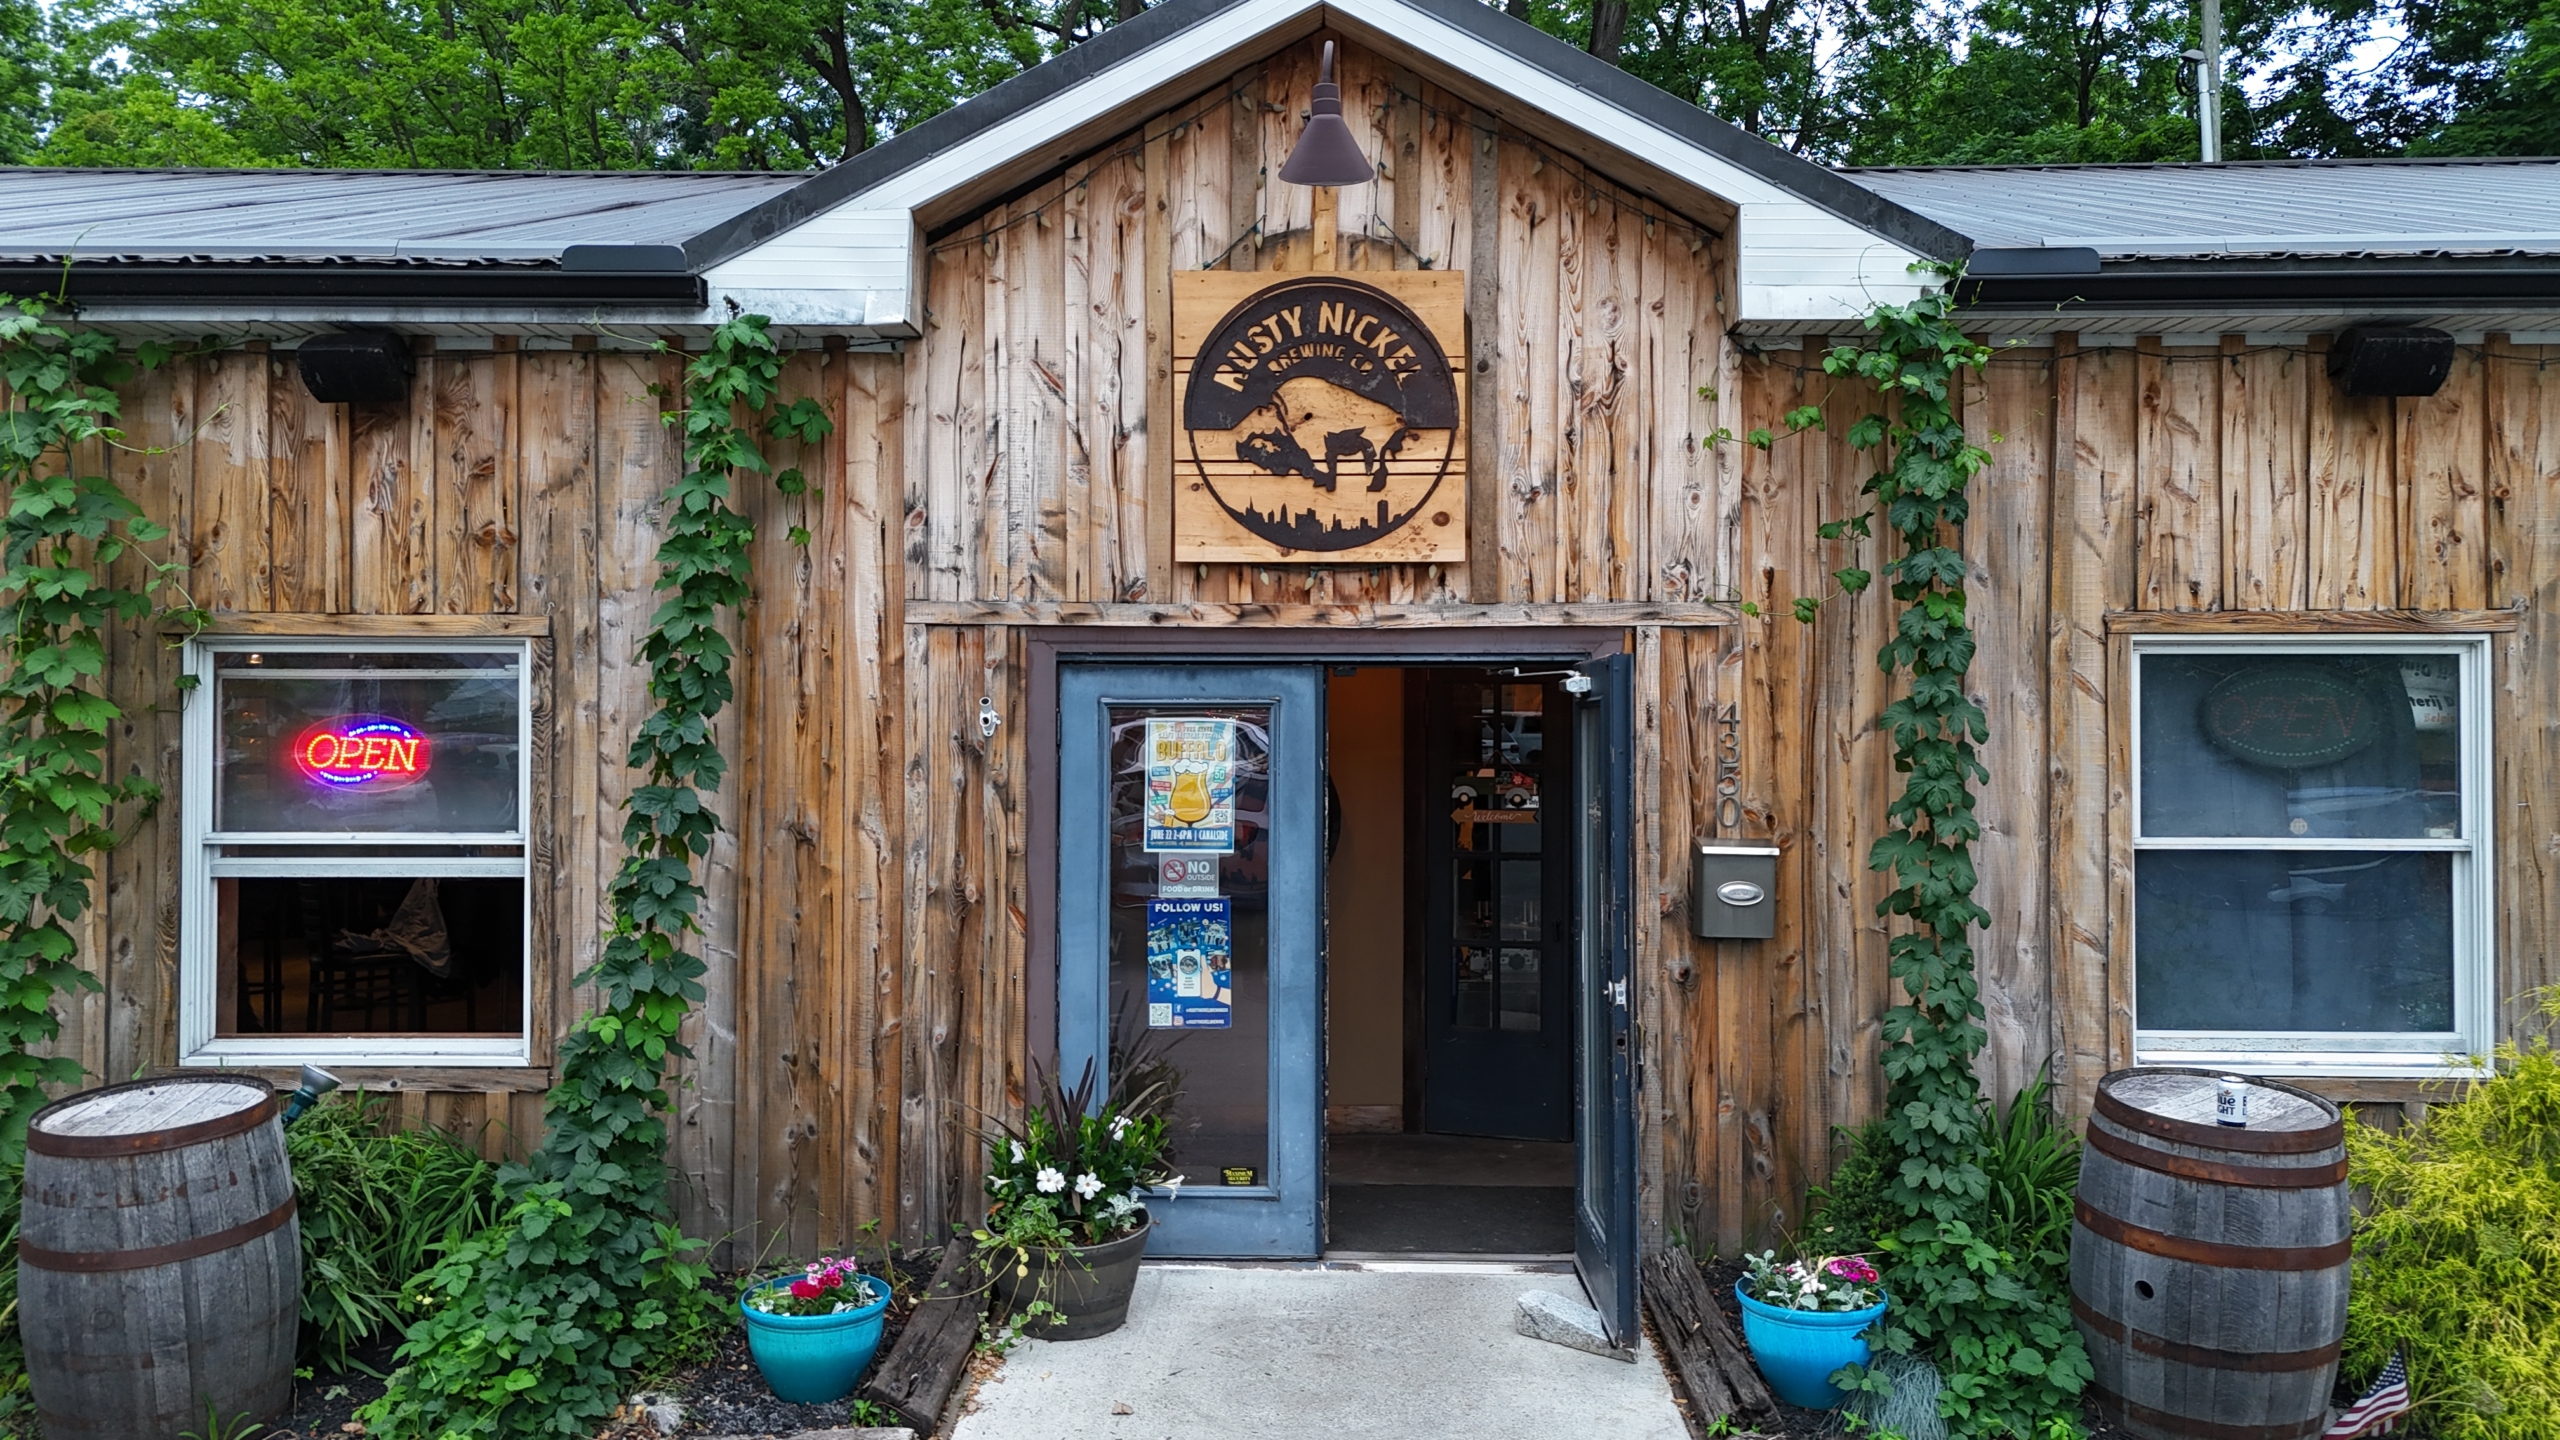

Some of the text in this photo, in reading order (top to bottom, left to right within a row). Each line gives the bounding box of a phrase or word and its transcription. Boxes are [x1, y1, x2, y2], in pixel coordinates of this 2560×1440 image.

[1213, 301, 1422, 392] RUSTY NICKEL
[1267, 343, 1346, 377] BREWING
[2215, 695, 2363, 738] OPEN
[306, 734, 419, 771] OPEN
[1157, 740, 1227, 762] BUFFALO
[1717, 701, 1740, 828] 4350
[1214, 771, 1225, 780] 50
[1465, 811, 1521, 821] Welcome
[1150, 829, 1164, 840] JUNE
[1165, 829, 1173, 840] 22
[1199, 829, 1229, 840] CANALSIDE
[1187, 861, 1210, 874] NO
[1162, 885, 1183, 893] FOOD
[1192, 885, 1216, 893] DRINK
[1155, 903, 1223, 913] FOLLOW US!
[2217, 1093, 2236, 1107] lue
